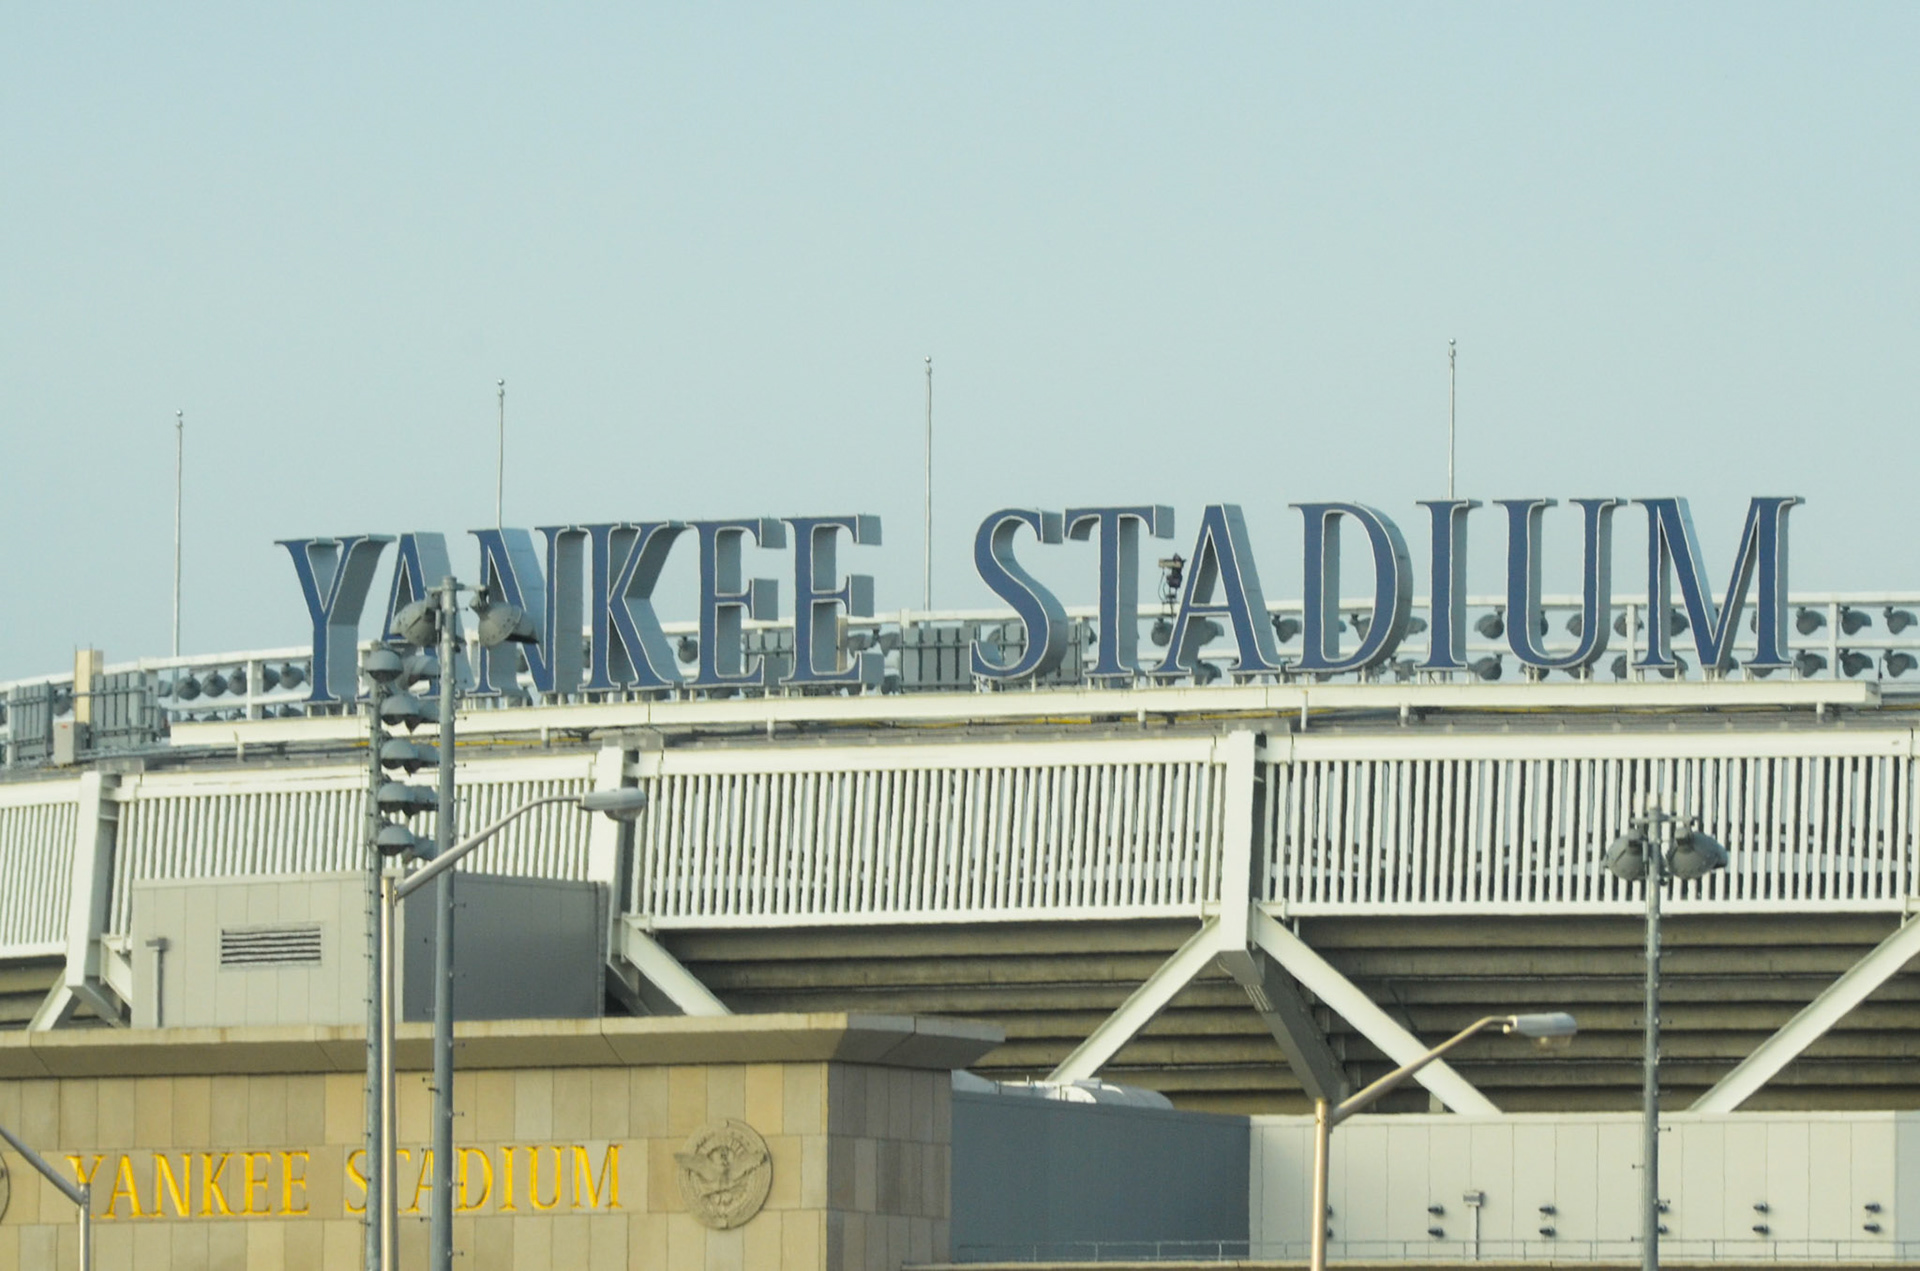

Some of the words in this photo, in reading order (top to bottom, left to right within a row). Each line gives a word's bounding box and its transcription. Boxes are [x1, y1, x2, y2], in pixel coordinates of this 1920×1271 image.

[274, 514, 882, 702] YANKEE
[969, 496, 1805, 681] STADIUM
[64, 1151, 310, 1219] YANKEE
[345, 1144, 623, 1214] SADIUM
